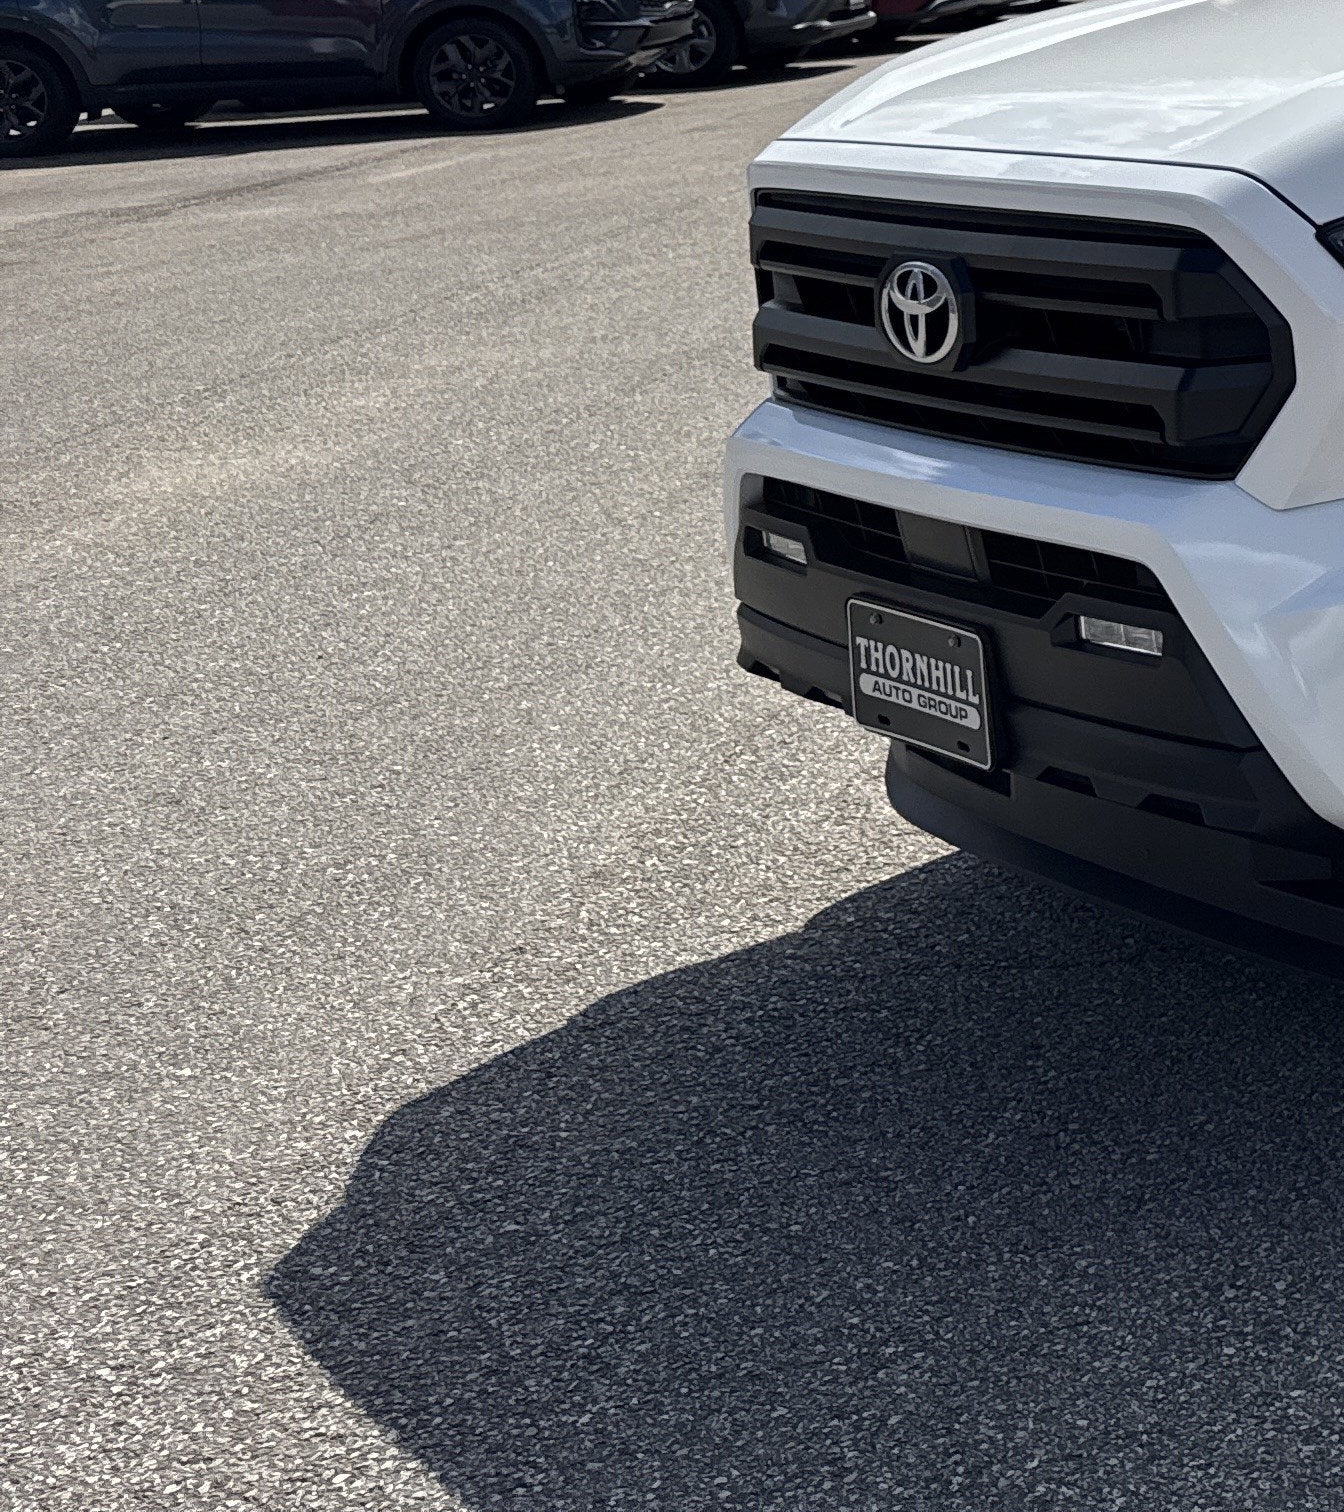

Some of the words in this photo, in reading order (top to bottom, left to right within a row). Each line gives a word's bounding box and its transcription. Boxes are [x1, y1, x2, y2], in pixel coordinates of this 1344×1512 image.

[855, 636, 980, 705] THORNHILL
[872, 680, 913, 704] AUTO
[917, 693, 969, 721] GROUP
